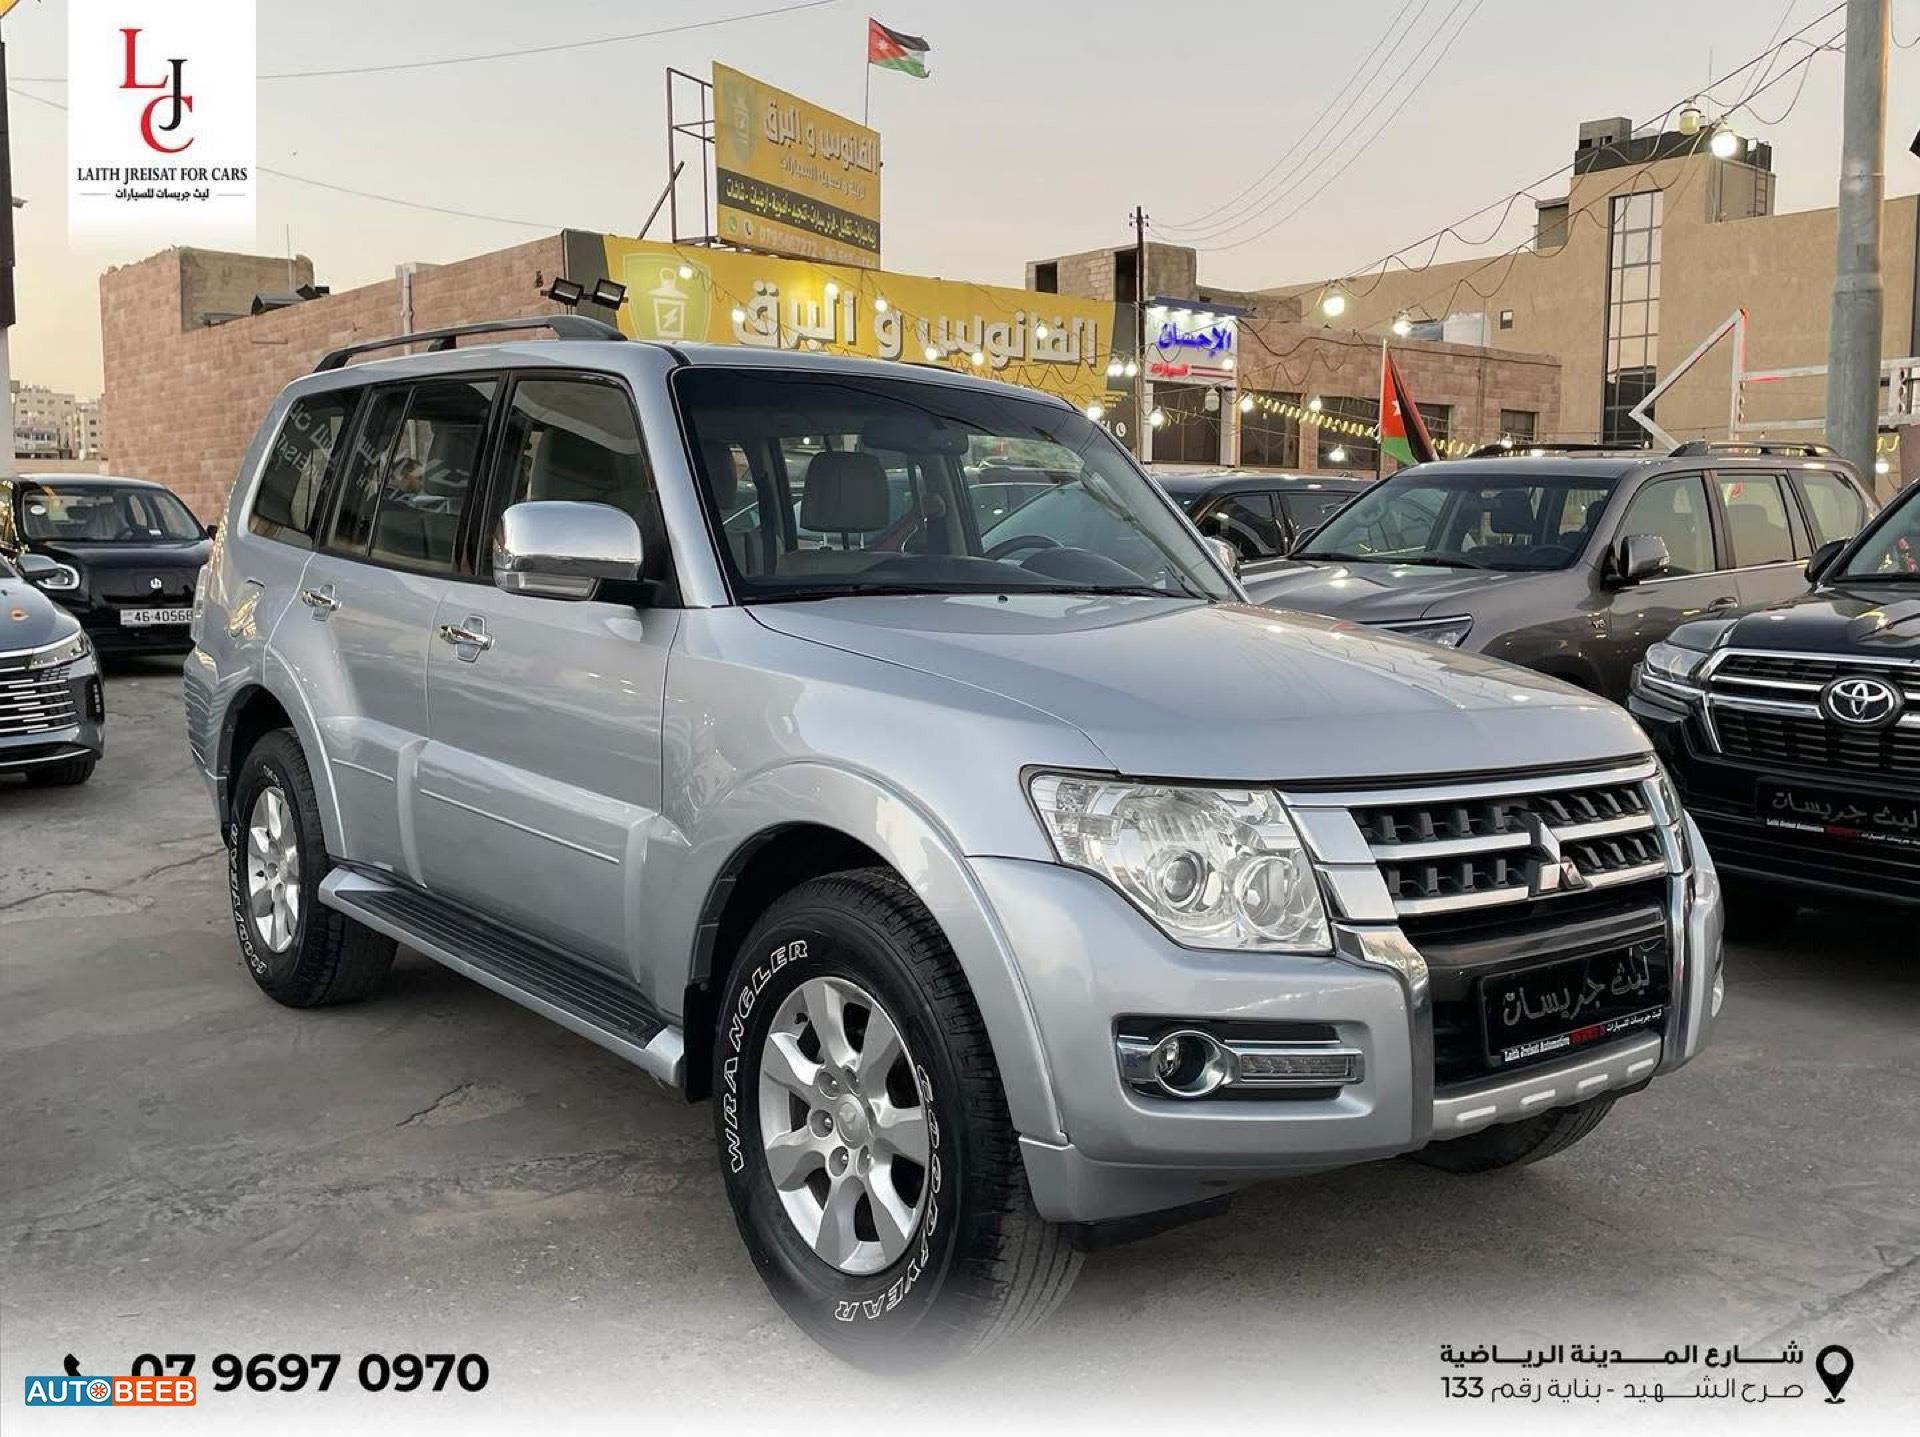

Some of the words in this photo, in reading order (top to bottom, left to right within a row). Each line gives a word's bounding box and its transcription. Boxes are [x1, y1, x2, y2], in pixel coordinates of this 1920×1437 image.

[805, 119, 817, 157] و
[821, 129, 880, 175] الفانوس
[731, 278, 857, 350] البرق
[873, 308, 902, 360] و
[917, 310, 1098, 369] الفانوس
[1872, 806, 1918, 832] ليث
[723, 939, 809, 1175] WRANGLER
